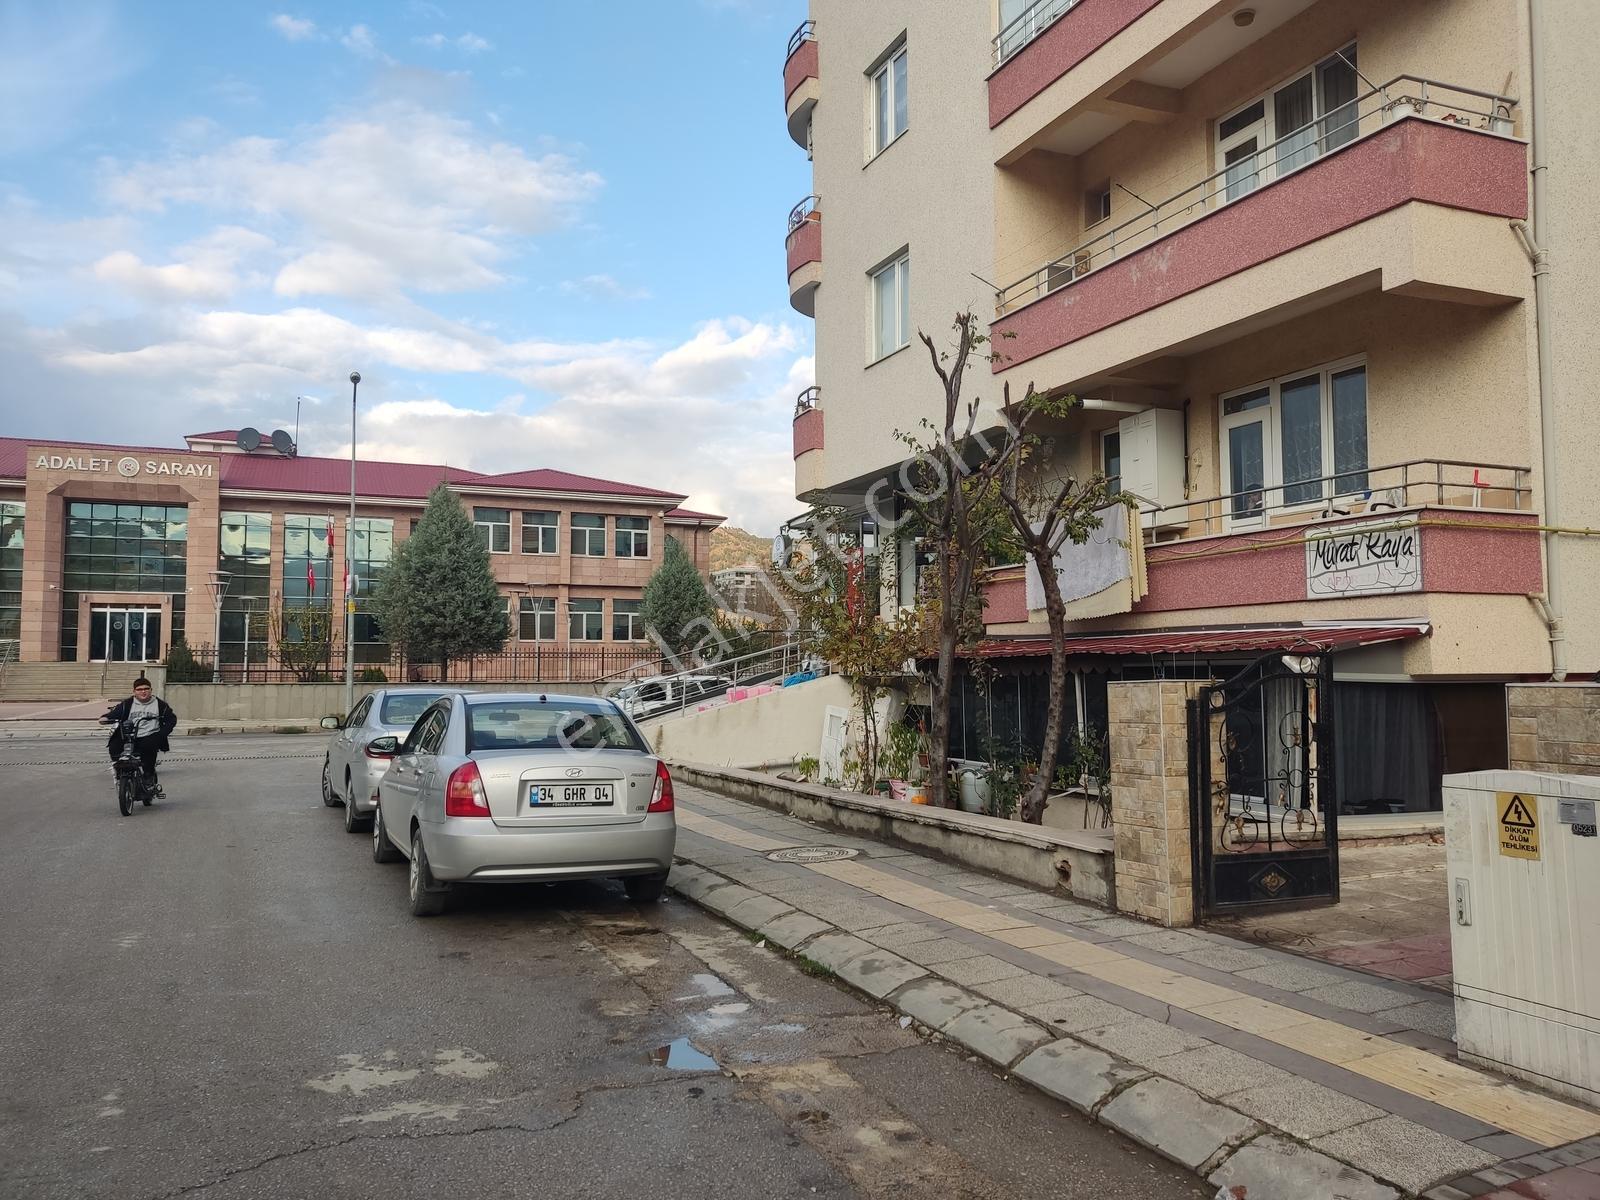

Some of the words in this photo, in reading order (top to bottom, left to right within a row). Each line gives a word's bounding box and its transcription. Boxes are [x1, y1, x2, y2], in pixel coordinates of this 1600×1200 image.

[35, 455, 113, 472] ADALET
[145, 460, 213, 477] SARAYI
[1312, 534, 1359, 573] Murat
[1366, 532, 1414, 568] Kaya
[540, 788, 553, 801] 34
[564, 787, 586, 801] GHR
[594, 787, 608, 800] 04
[1509, 834, 1529, 842] ÖLÜM
[1502, 841, 1537, 852] TEHLİKESİ
